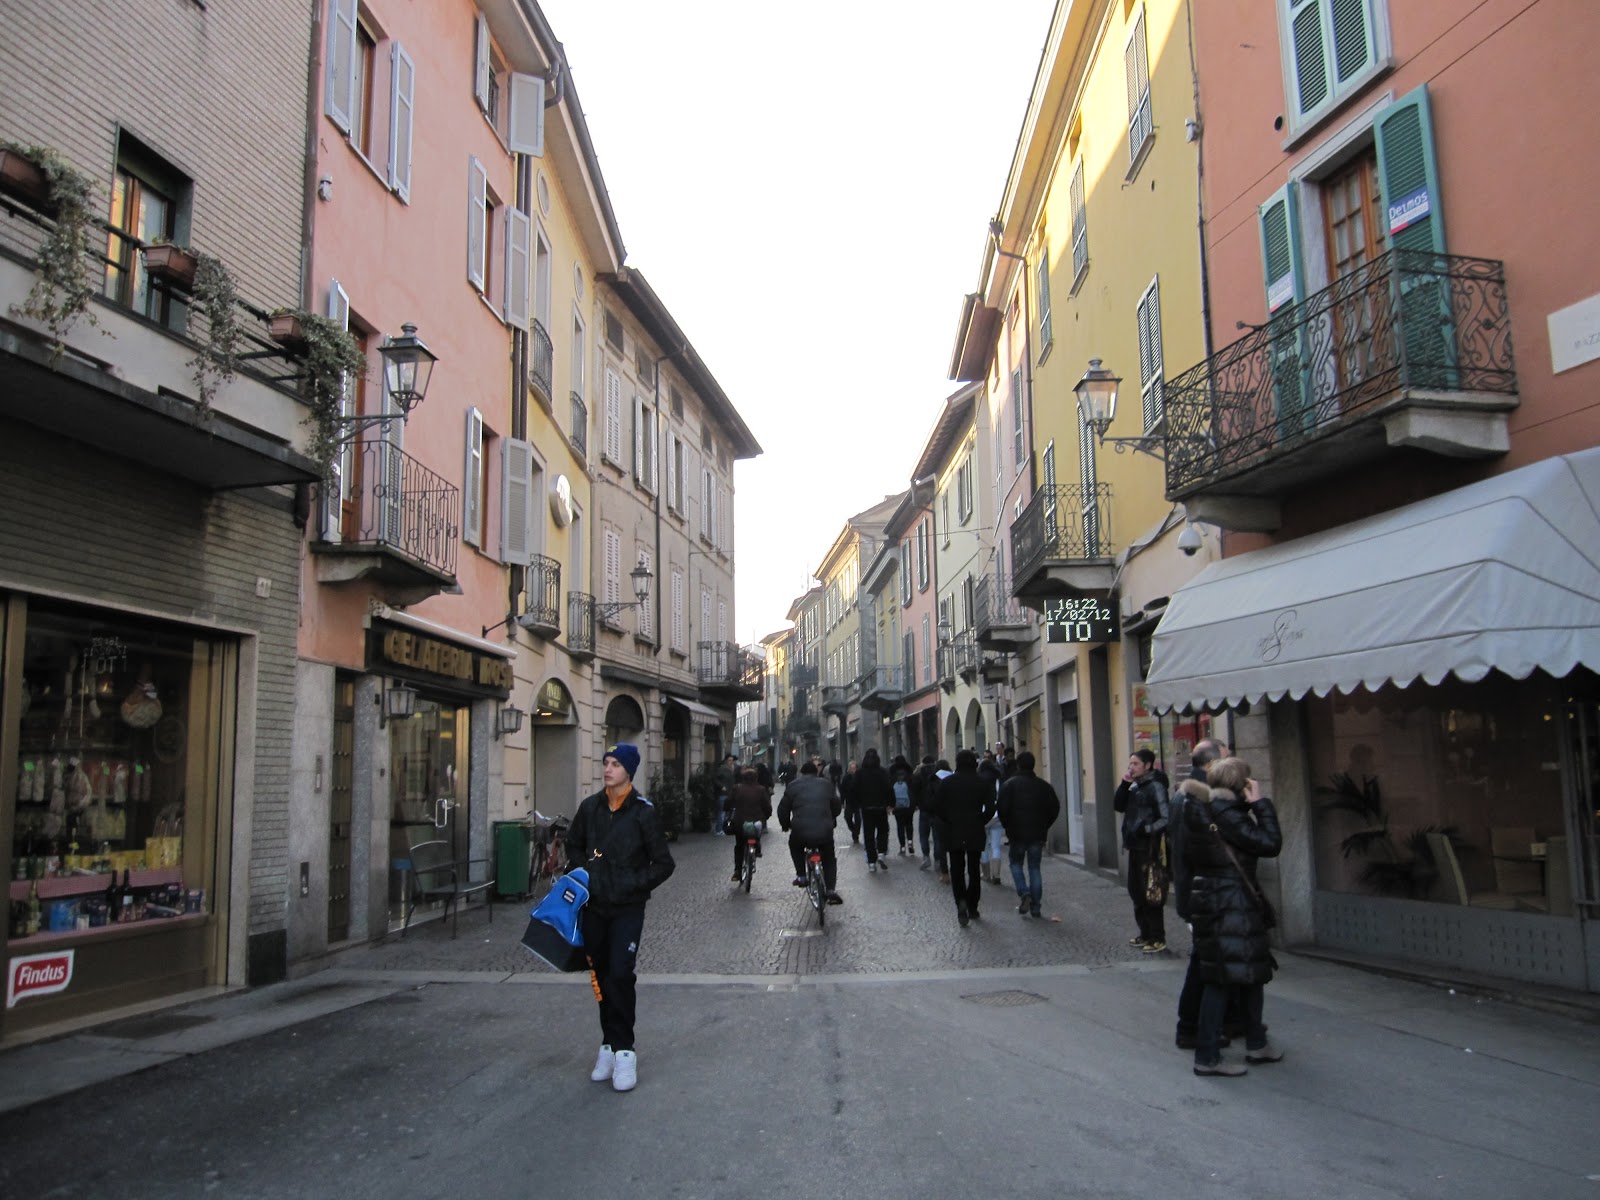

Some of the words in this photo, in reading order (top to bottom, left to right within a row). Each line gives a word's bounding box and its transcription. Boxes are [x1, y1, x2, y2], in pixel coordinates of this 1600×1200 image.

[1058, 598, 1098, 610] 16:22
[1046, 608, 1111, 620] 17/02/12
[383, 629, 474, 681] GELATERIA
[17, 964, 65, 986] Findus
